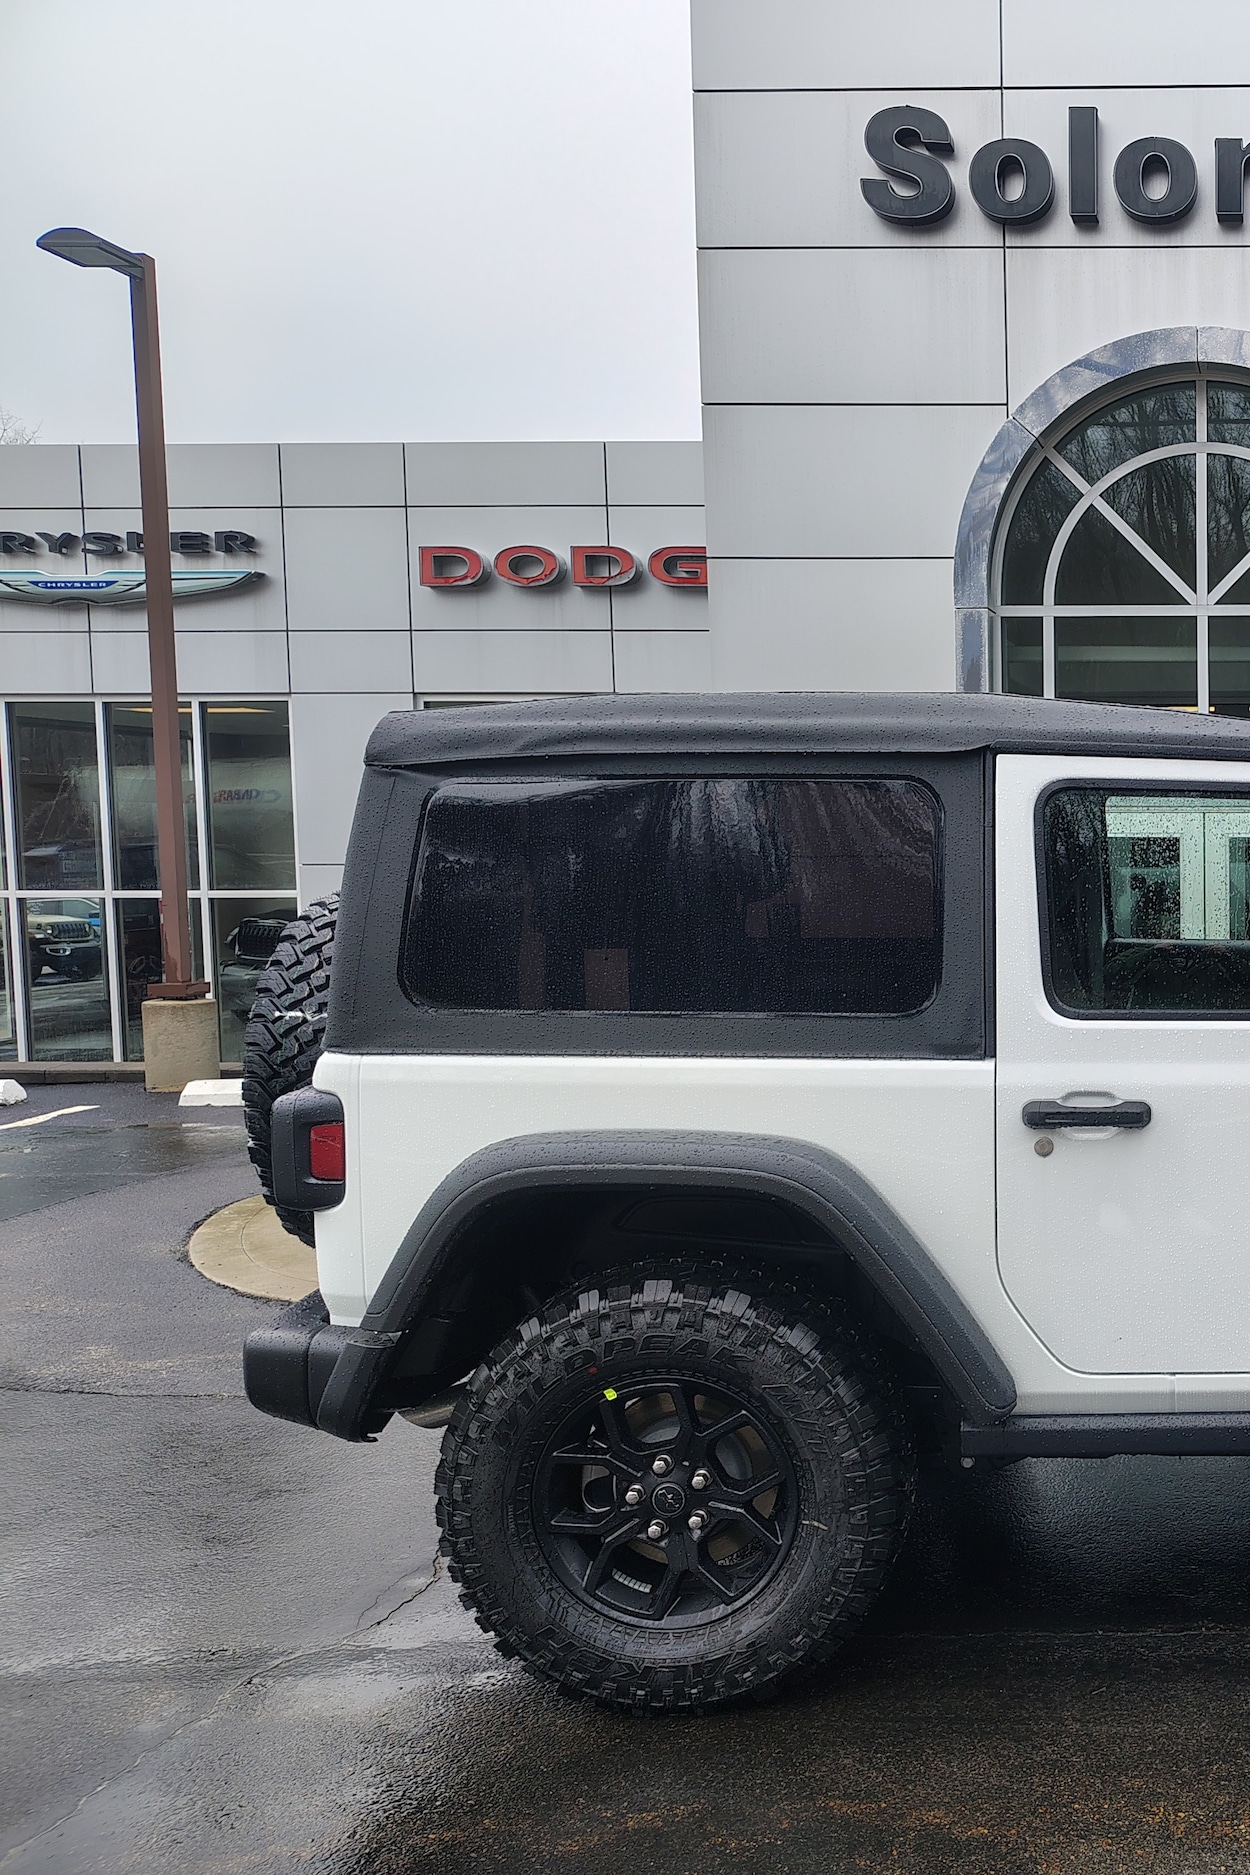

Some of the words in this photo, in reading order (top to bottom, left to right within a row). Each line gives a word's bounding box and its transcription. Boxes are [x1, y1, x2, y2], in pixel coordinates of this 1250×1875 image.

[37, 581, 107, 589] CHRYSLER
[418, 545, 708, 588] DODG
[488, 1334, 756, 1452] WILDPEAK
